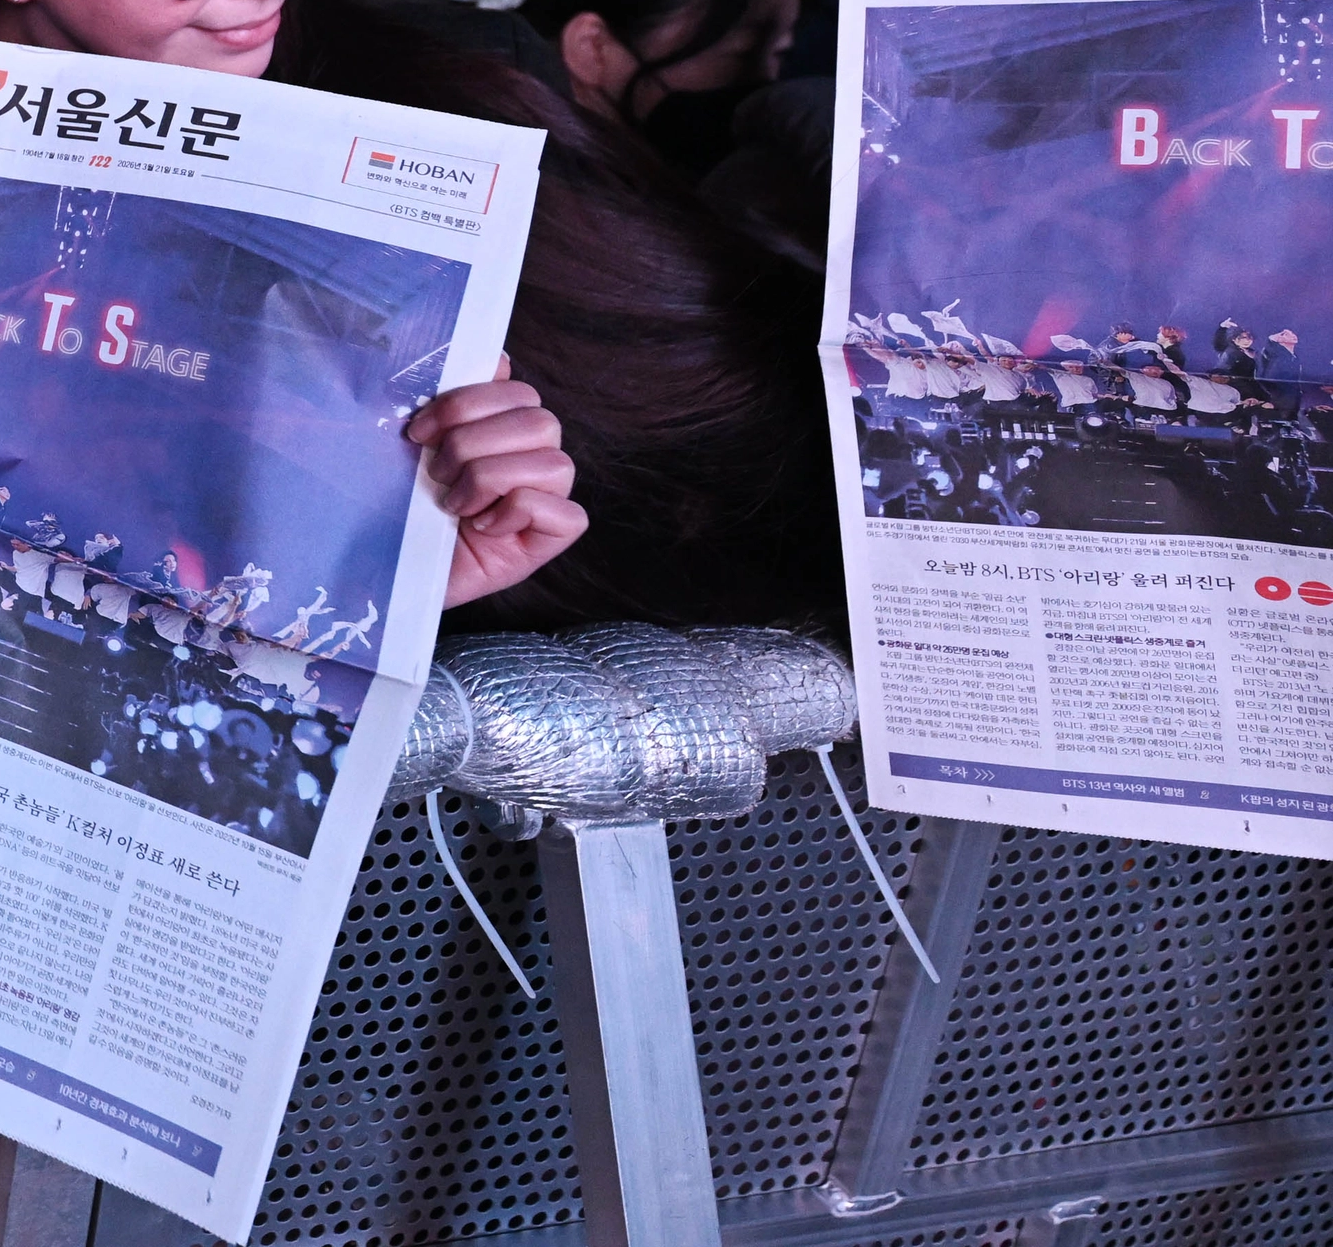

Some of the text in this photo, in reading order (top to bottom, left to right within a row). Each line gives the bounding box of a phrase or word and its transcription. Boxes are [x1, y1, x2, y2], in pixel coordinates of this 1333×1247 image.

[1120, 108, 1253, 167] BACK
[21, 148, 44, 158] 1904년
[87, 154, 113, 169] 122
[116, 158, 195, 178] 2026년 3월 21일 토요일
[398, 158, 475, 185] HOBAN
[366, 171, 468, 200] 변화와 혁신으로 여는 미래
[419, 208, 442, 224] 컴백
[42, 292, 83, 354] TO
[98, 305, 210, 381] STAGE
[923, 558, 977, 577] 오늘밤
[980, 563, 1014, 580] 8시,
[1016, 565, 1056, 582] BTS
[1129, 571, 1168, 589] 울려
[1175, 573, 1236, 592] 퍼진다
[939, 764, 968, 779] 목차
[1061, 777, 1185, 798] BTS 13년 역사와 새 앨범
[1239, 793, 1274, 806] K팝의
[1275, 797, 1300, 809] 성지
[1301, 799, 1314, 811] 된
[65, 813, 113, 846] K컬처
[116, 835, 164, 866] 이정표
[167, 856, 201, 881] 새로
[204, 870, 241, 897] 쓴다
[58, 1082, 88, 1105] 10년간
[158, 1128, 181, 1148] 보니
